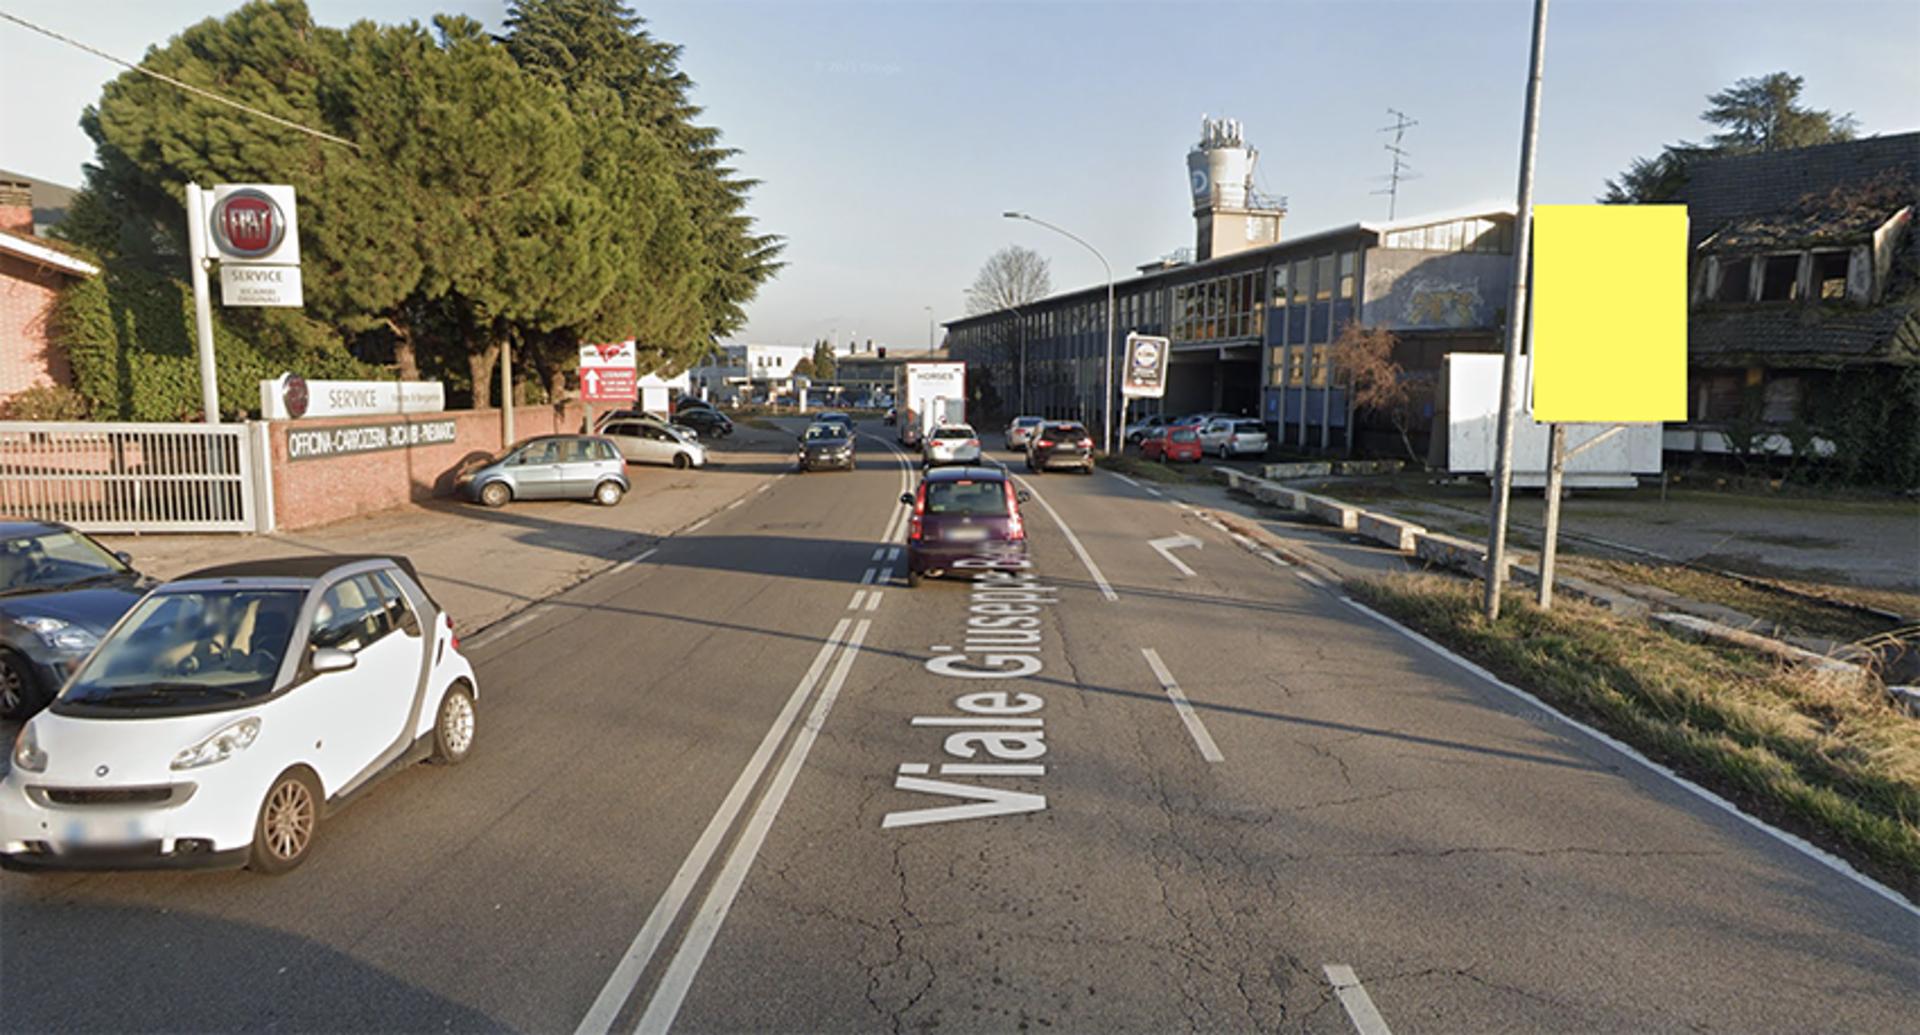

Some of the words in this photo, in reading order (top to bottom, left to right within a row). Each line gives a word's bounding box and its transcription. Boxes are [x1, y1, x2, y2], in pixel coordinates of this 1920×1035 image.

[229, 208, 268, 239] FIAT
[231, 270, 283, 283] SERVICE
[328, 389, 377, 409] SERVICE
